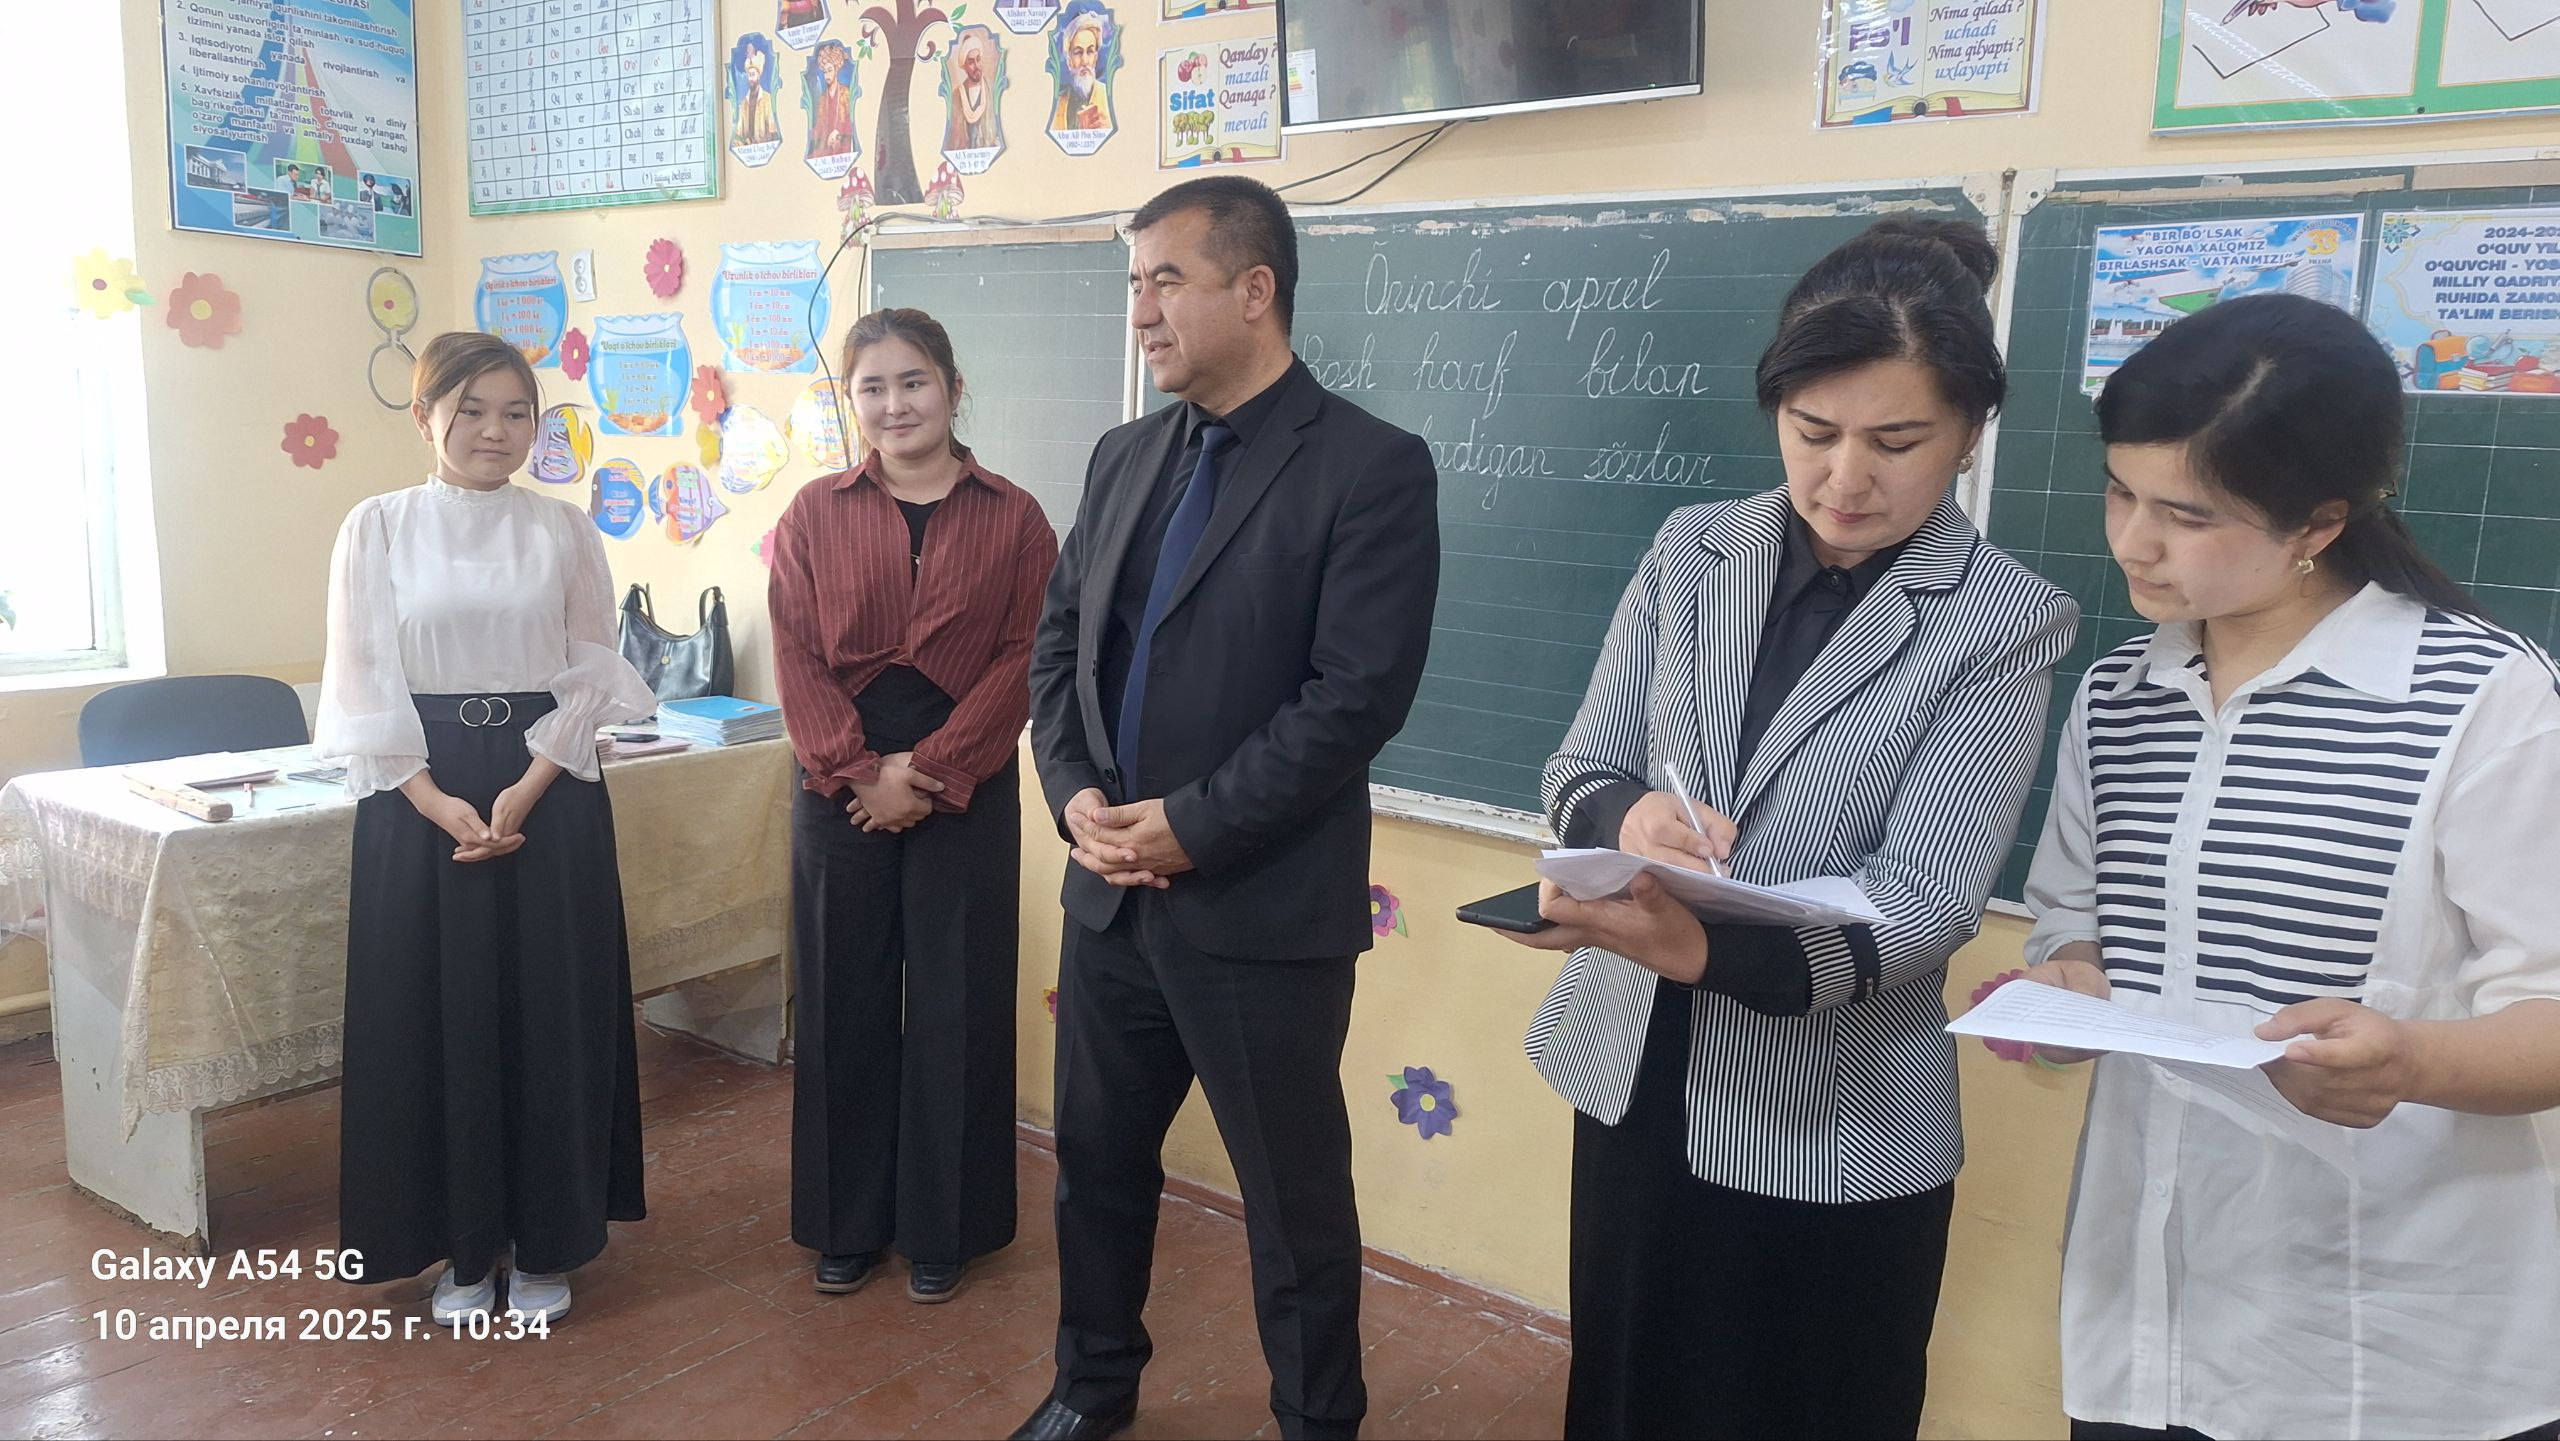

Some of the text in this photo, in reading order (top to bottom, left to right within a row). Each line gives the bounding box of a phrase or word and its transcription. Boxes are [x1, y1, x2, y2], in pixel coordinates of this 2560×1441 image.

[1929, 0, 2025, 23] Nima qiladi ?
[187, 16, 315, 49] tizimini yanada islox qilish
[190, 3, 224, 17] Qonun
[228, 12, 289, 31] ustuvorligini
[358, 39, 405, 56] sud-huquq
[324, 14, 397, 36] takomillashtirish
[1944, 19, 1999, 41] uchadi
[178, 31, 187, 41] 3.
[191, 34, 253, 54] Iqtisodiyotni
[271, 52, 305, 64] yanada
[323, 61, 379, 79] rivojlantirish
[189, 47, 265, 69] liberallashtirish
[1219, 42, 1269, 69] Qanday
[1926, 38, 2025, 61] Nima qilyapti ?
[193, 66, 229, 82] Ijtimoiy
[267, 82, 326, 97] rivojlantirish
[1225, 63, 1270, 86] mazali
[1934, 58, 2011, 82] uxlayapti
[1169, 89, 1215, 112] Sifat
[1219, 88, 1266, 110] Qanaqa
[256, 97, 309, 112] millatlararo
[320, 107, 353, 119] totuvlik
[386, 118, 407, 130] diniy
[1224, 110, 1269, 133] mevali
[231, 118, 276, 131] manfaatli
[303, 130, 333, 142] amaliy
[341, 135, 374, 148] ruxdagi
[381, 141, 407, 154] tashqi
[326, 121, 357, 132] chuqur
[2136, 243, 2194, 256] YAGONA
[2199, 240, 2266, 254] XALQMIZ
[2098, 258, 2187, 271] BIRLASHSAK
[2432, 275, 2490, 288] MILLIY
[1542, 247, 1670, 341] aprel
[2435, 292, 2500, 304] RUHIDA
[1413, 329, 1519, 421] harf
[1577, 326, 1711, 399] bilan
